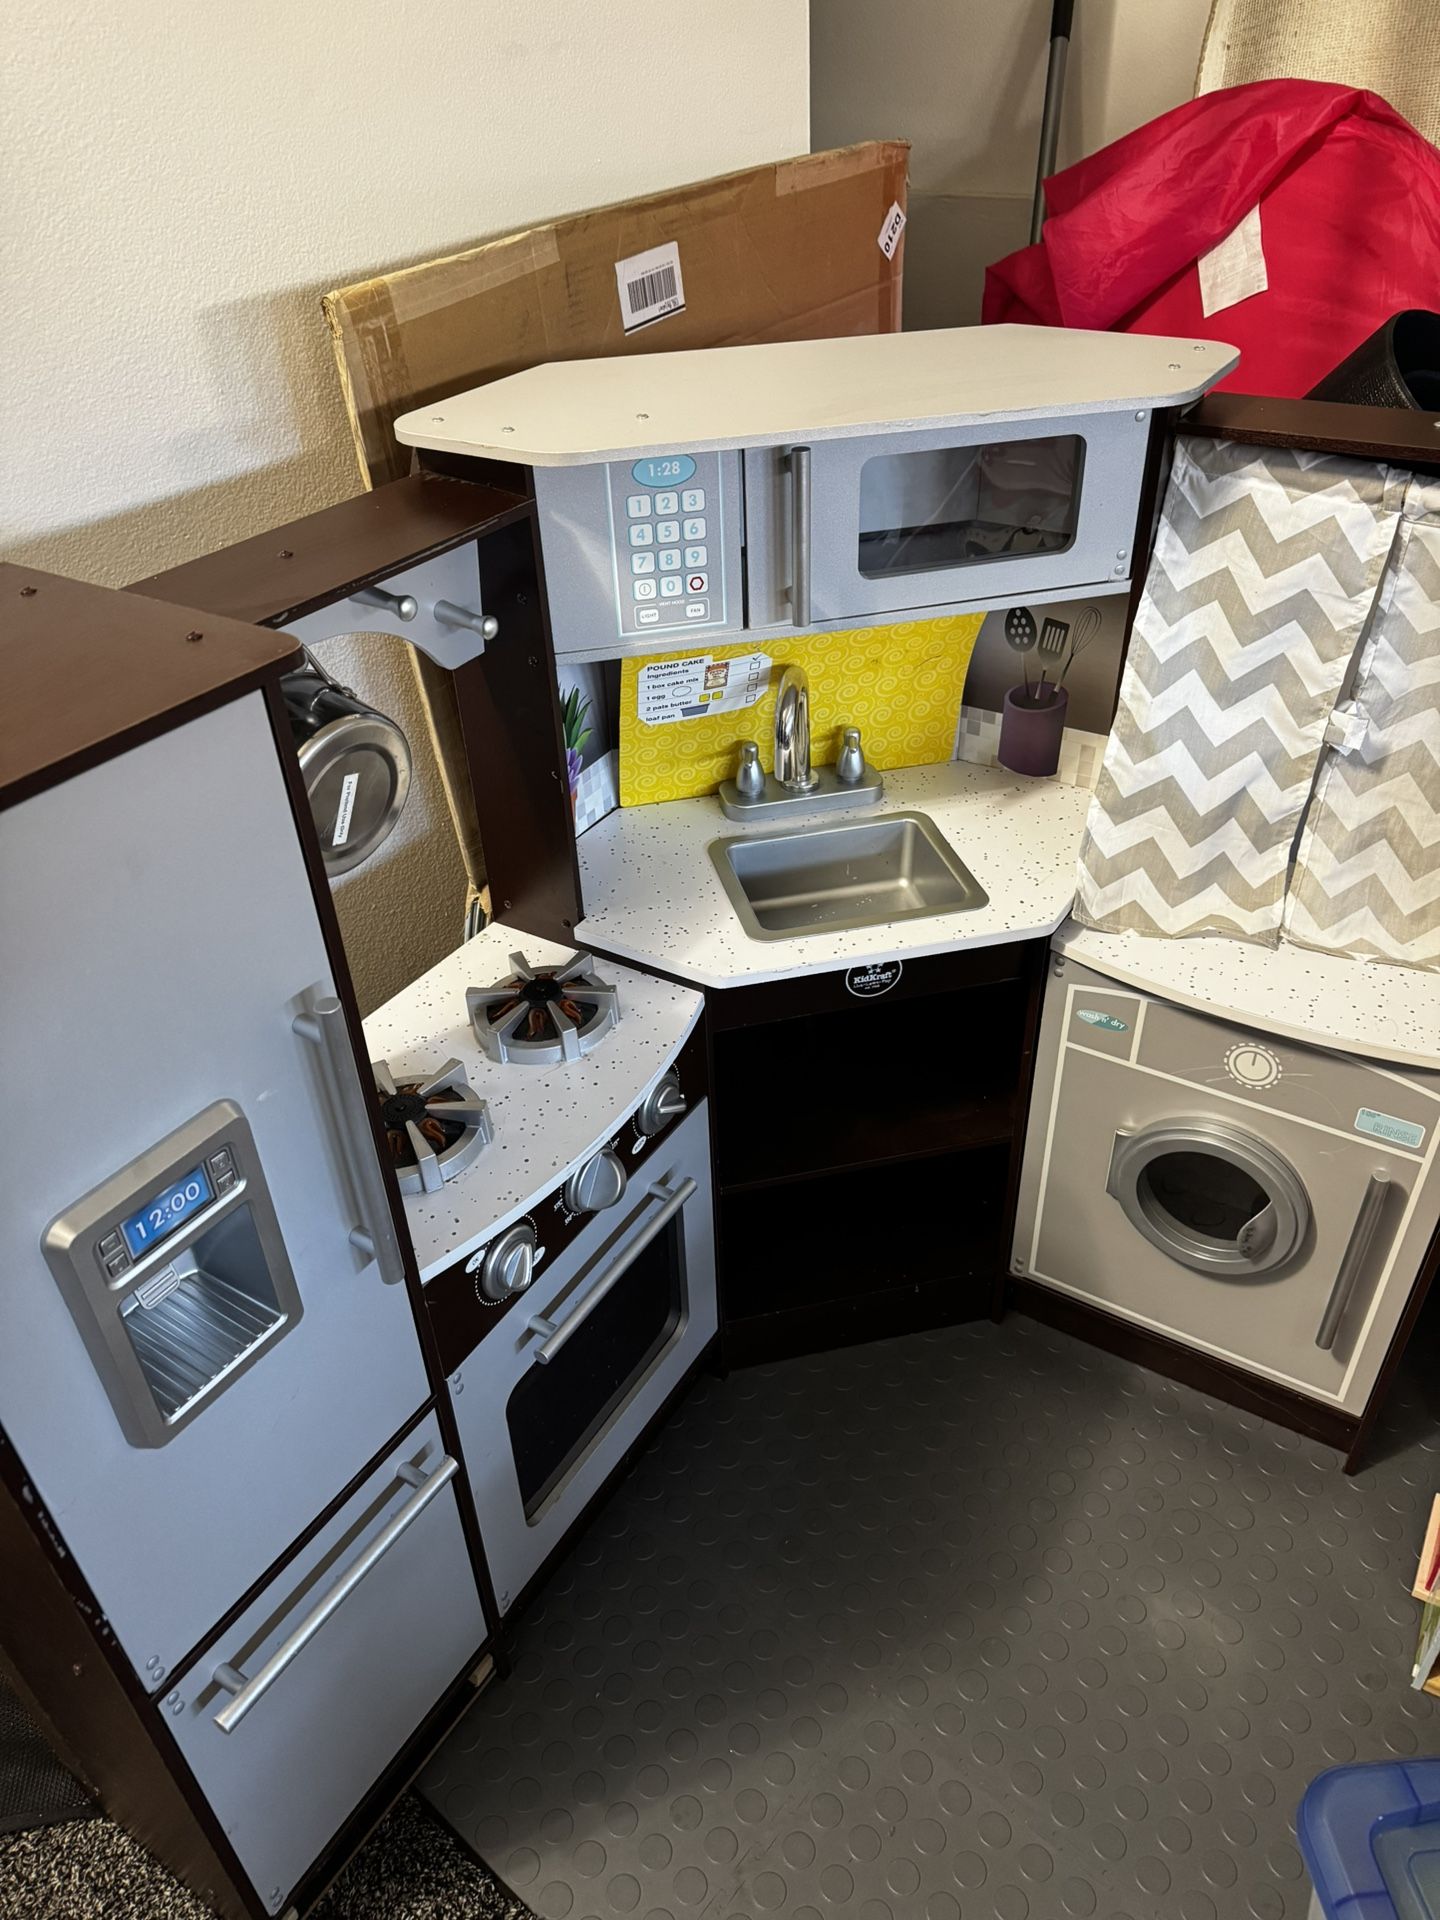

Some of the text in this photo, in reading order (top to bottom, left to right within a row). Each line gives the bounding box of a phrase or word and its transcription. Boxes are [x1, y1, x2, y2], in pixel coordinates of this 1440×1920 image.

[648, 461, 680, 477] 1:28
[662, 497, 671, 510] 2
[689, 494, 697, 507] 3
[636, 523, 698, 541] 4 5 6
[638, 551, 700, 569] 7 8 9
[647, 658, 704, 672] POUND CAKE
[647, 668, 689, 679] Ingredients
[652, 694, 666, 702] egg
[670, 699, 692, 708] butter
[662, 713, 675, 721] pan
[853, 972, 892, 984] KidKraft
[1077, 1010, 1101, 1022] wash
[1110, 1019, 1125, 1030] dry
[135, 1182, 200, 1239] 12:00
